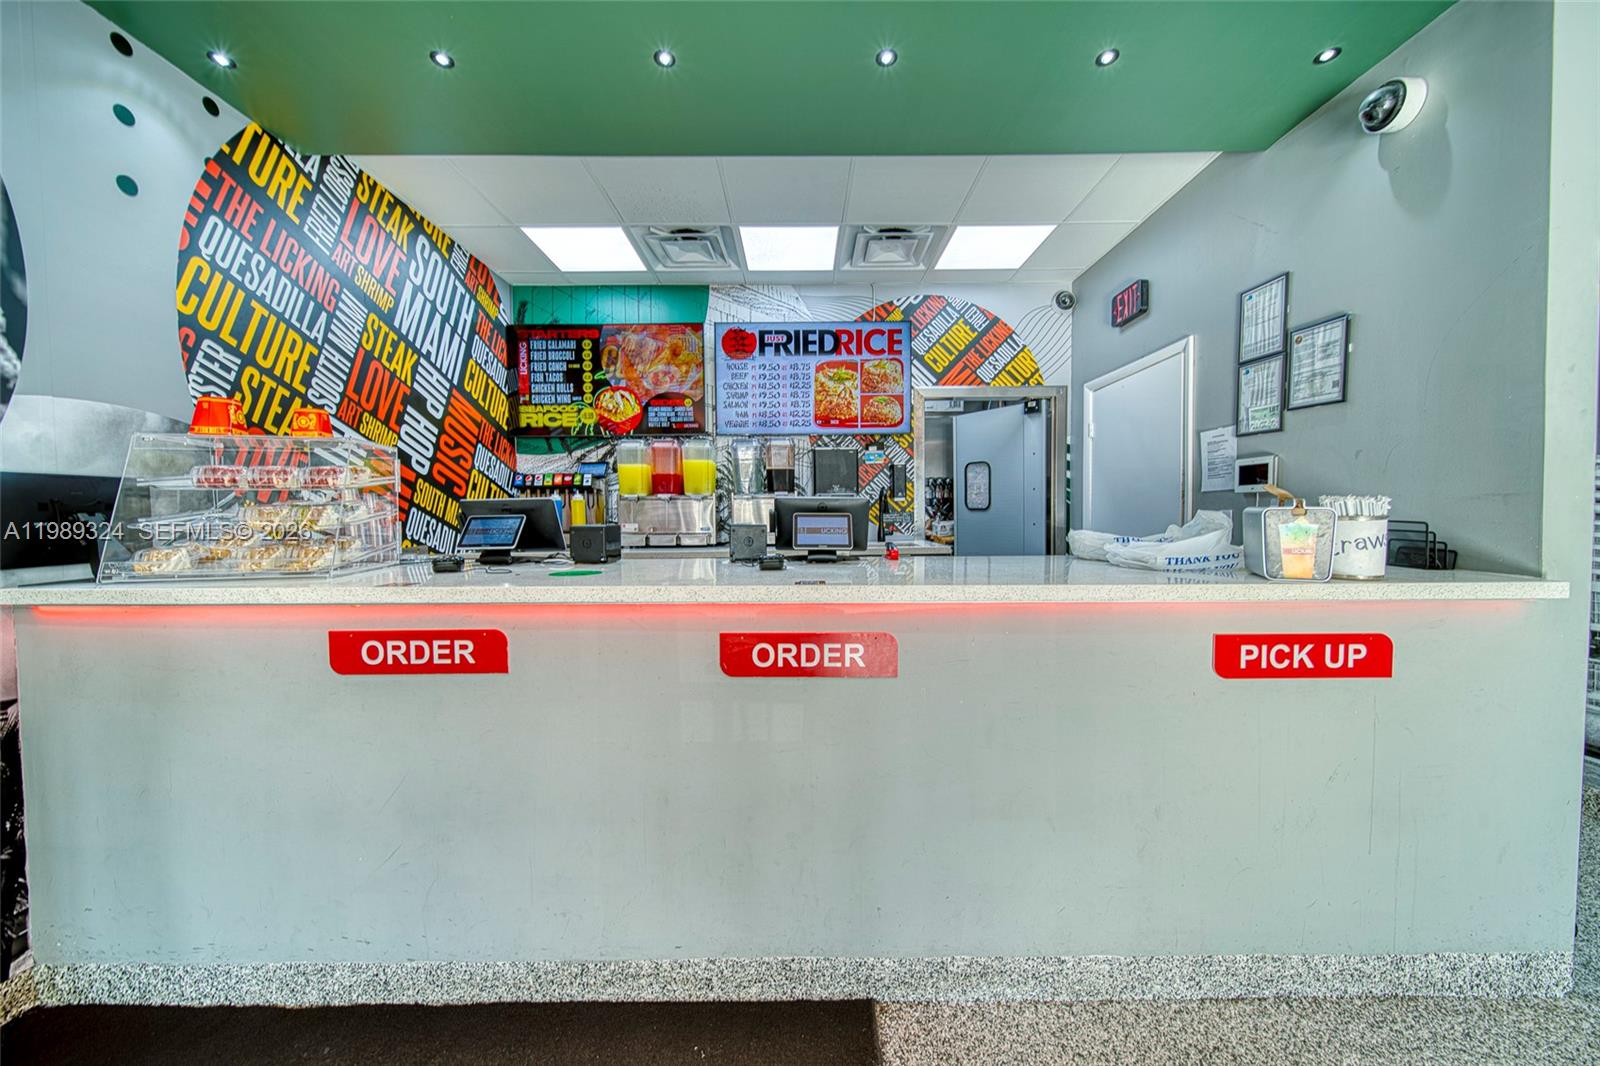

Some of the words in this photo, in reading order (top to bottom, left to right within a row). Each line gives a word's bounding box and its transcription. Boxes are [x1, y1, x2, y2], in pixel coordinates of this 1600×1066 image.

[221, 121, 313, 225] TURE
[303, 193, 342, 256] FRIED
[356, 171, 415, 255] STEAK
[213, 170, 265, 242] THE
[260, 217, 341, 313] LICKING
[340, 197, 407, 297] LOVE
[198, 214, 328, 346] QUESADILLA
[331, 243, 358, 278] ART
[354, 265, 395, 315] SHRIMP
[409, 234, 476, 342] SOUTH
[476, 284, 499, 321] SHRIMP
[1116, 283, 1137, 324] EXIT
[176, 256, 319, 396] CULTURE
[327, 288, 369, 359] MIAMI
[394, 279, 467, 387] MIAMI
[475, 309, 494, 347] THE
[529, 340, 546, 349] FRIED
[547, 340, 576, 349] CALAMARI
[912, 305, 961, 355] QUESADILLA
[923, 318, 978, 374] CULTURE
[962, 347, 986, 371] THE
[976, 319, 1014, 358] LICKING
[188, 338, 242, 406] STER
[361, 312, 419, 388] STEAK
[519, 341, 528, 375] LICKING
[529, 351, 546, 360] FRIED
[548, 351, 575, 360] BROCCOLI
[530, 362, 547, 371] FRIED
[976, 332, 1025, 383] QUESADILLA
[233, 365, 303, 437] STEA
[307, 342, 352, 416] SOUTH
[345, 346, 411, 433] LOVE
[413, 356, 450, 420] HIP
[463, 358, 510, 432] CULTURE
[531, 373, 543, 382] FISH
[545, 373, 563, 382] TACOS
[531, 384, 555, 393] CHICKEN
[531, 395, 555, 404] CHICKEN
[723, 382, 749, 390] CHICKEN
[336, 397, 363, 429] ART
[359, 412, 399, 448] SHRIMP
[518, 405, 577, 413] SEAFOOD
[518, 413, 577, 428] RICE
[723, 401, 749, 409] SALMON
[396, 404, 439, 476] HOP
[432, 387, 483, 497] MUSIC
[478, 415, 496, 450] THE
[413, 477, 448, 512] SOUTH
[473, 442, 520, 497] QUESADILL
[1165, 555, 1211, 566] THANK
[1334, 534, 1387, 556] raw
[361, 639, 476, 666] ORDER
[752, 643, 866, 668] ORDER
[1240, 643, 1315, 669] PICK
[1324, 643, 1368, 669] UP
